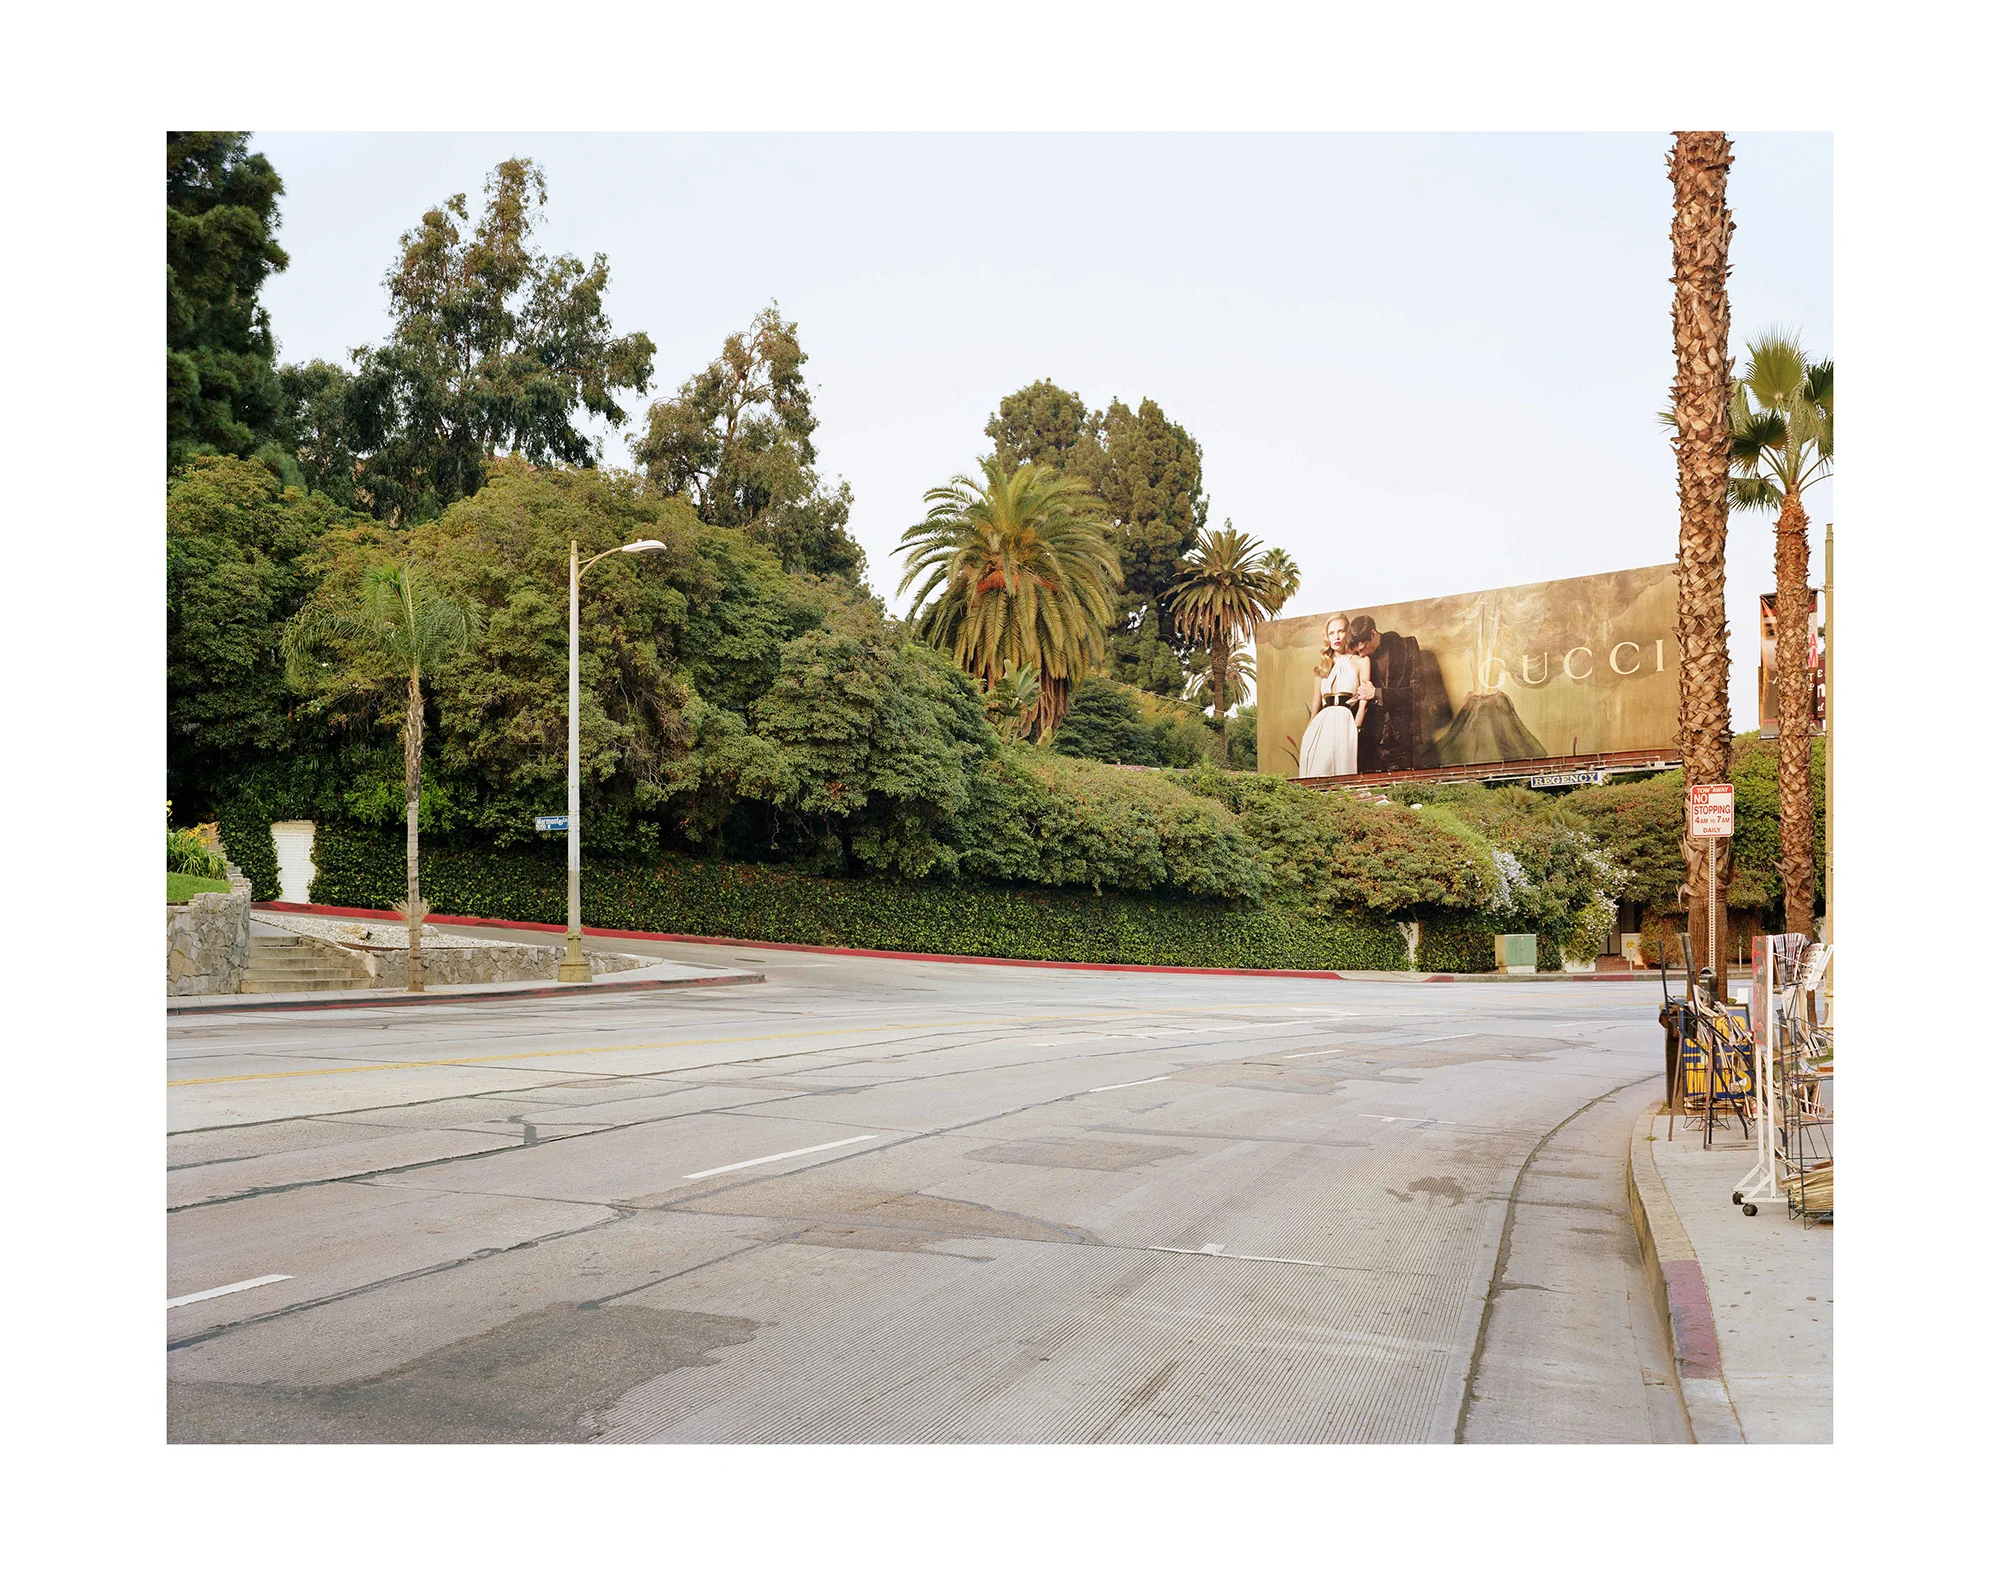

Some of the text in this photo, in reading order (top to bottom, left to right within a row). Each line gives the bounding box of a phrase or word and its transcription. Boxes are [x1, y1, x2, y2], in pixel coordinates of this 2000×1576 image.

[1478, 639, 1665, 689] GUCCI
[1535, 773, 1596, 786] REGENCY
[1693, 794, 1708, 804] NO
[1694, 805, 1731, 815] STOPPING
